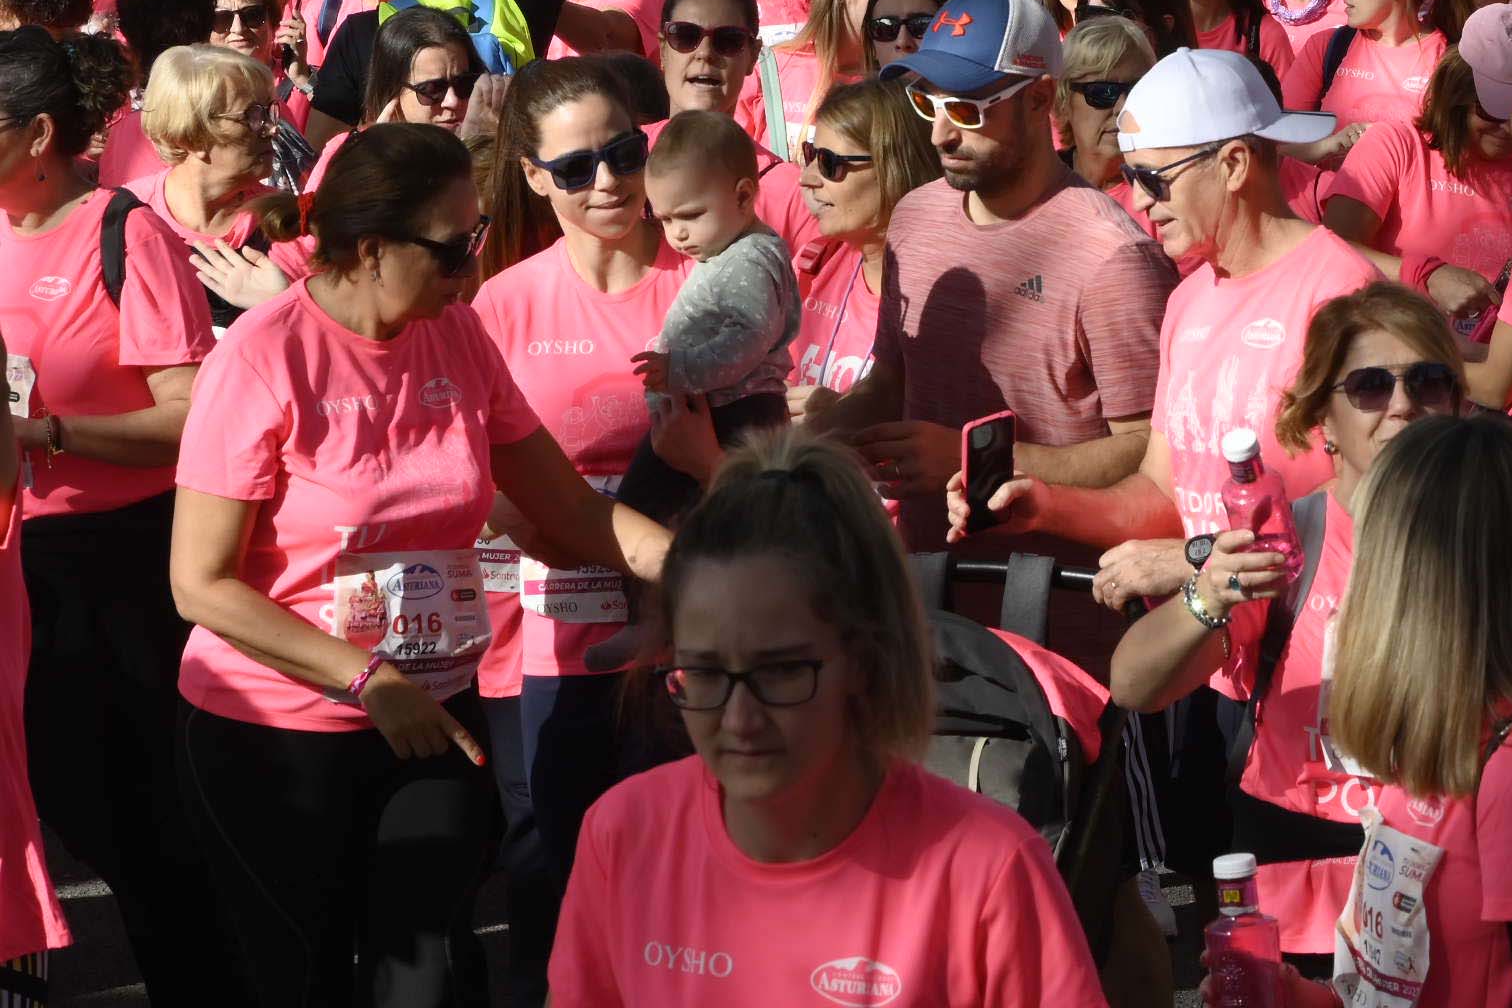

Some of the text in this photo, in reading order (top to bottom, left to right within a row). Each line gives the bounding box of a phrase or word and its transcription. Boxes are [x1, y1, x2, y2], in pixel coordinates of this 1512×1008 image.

[527, 338, 594, 356] OYSHO
[316, 394, 378, 417] OYSHO
[481, 551, 511, 561] MUJER
[537, 580, 623, 591] CARRERA DE LA MUJ
[536, 601, 578, 614] OYSHO
[392, 611, 443, 636] 016
[643, 940, 734, 979] OYSHO
[818, 971, 895, 997] ASTURIANA
